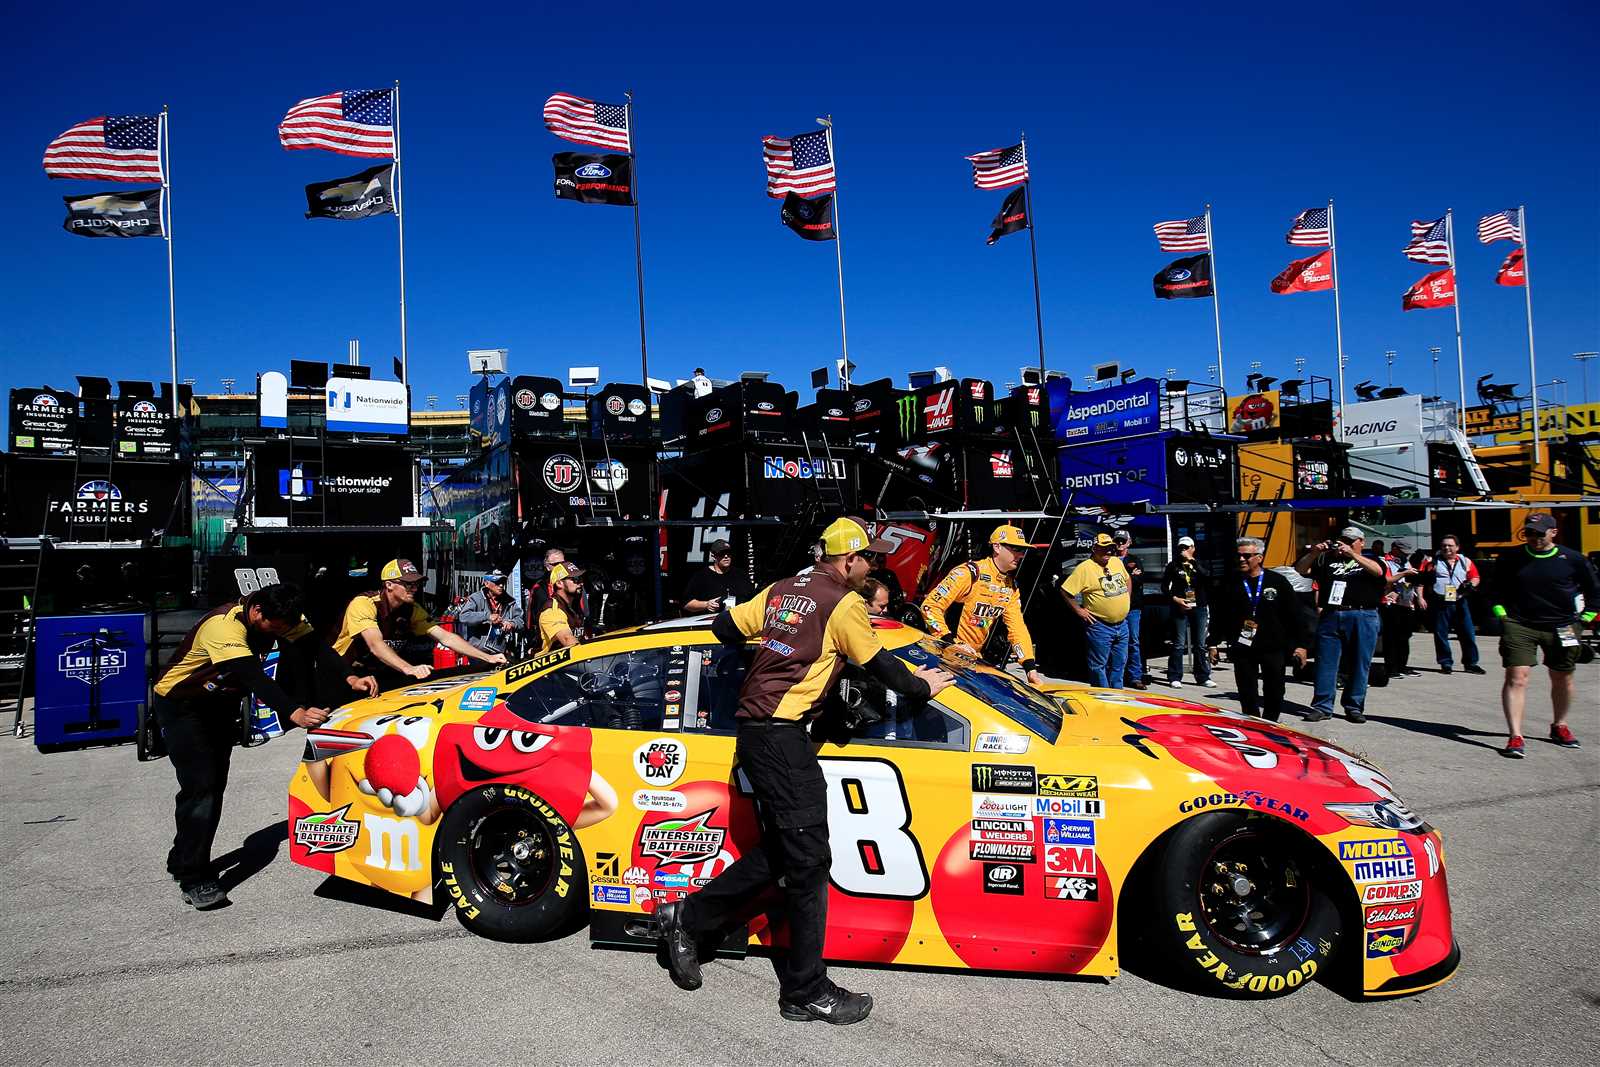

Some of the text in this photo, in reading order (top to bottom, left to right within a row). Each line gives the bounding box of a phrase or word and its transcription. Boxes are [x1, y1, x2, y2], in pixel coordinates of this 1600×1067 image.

[356, 395, 403, 405] Nationwide
[17, 403, 73, 414] FARMERS
[119, 411, 171, 420] FARMERS
[765, 457, 825, 478] Mobil
[319, 476, 390, 487] Nationwide
[1065, 469, 1148, 488] DENTIST OF
[50, 501, 148, 513] FARMERS
[847, 538, 862, 550] 18
[235, 567, 281, 596] 88
[508, 650, 567, 680] STANLEY
[648, 743, 678, 754] RED
[645, 765, 674, 778] DAY
[993, 769, 1033, 778] MONSTER
[1076, 790, 1097, 798] WEAR
[1005, 803, 1028, 812] LIGHT
[1036, 798, 1081, 813] Mobil
[1179, 791, 1310, 822] GOODYEAR
[299, 822, 355, 834] INTERSTATE
[817, 755, 931, 901] 8
[974, 820, 1023, 832] LINCOLN
[1061, 824, 1091, 832] SHERWIN
[301, 832, 351, 844] BATTERIES
[646, 830, 720, 842] INTERSTATE
[985, 831, 1028, 841] WELDERS
[648, 841, 715, 853] BATTERIES
[972, 842, 1033, 858] FLOWMASTER
[1342, 840, 1408, 859] MOOG
[1047, 847, 1095, 873] 3M
[1355, 858, 1415, 880] MAHLE
[590, 874, 620, 884] Cessna
[441, 861, 481, 920] EAGLE
[1366, 885, 1409, 900] COMP
[1367, 907, 1415, 923] Edelbrock
[1368, 937, 1403, 951] SUNOCO
[1175, 911, 1318, 993] GOODYEAR
